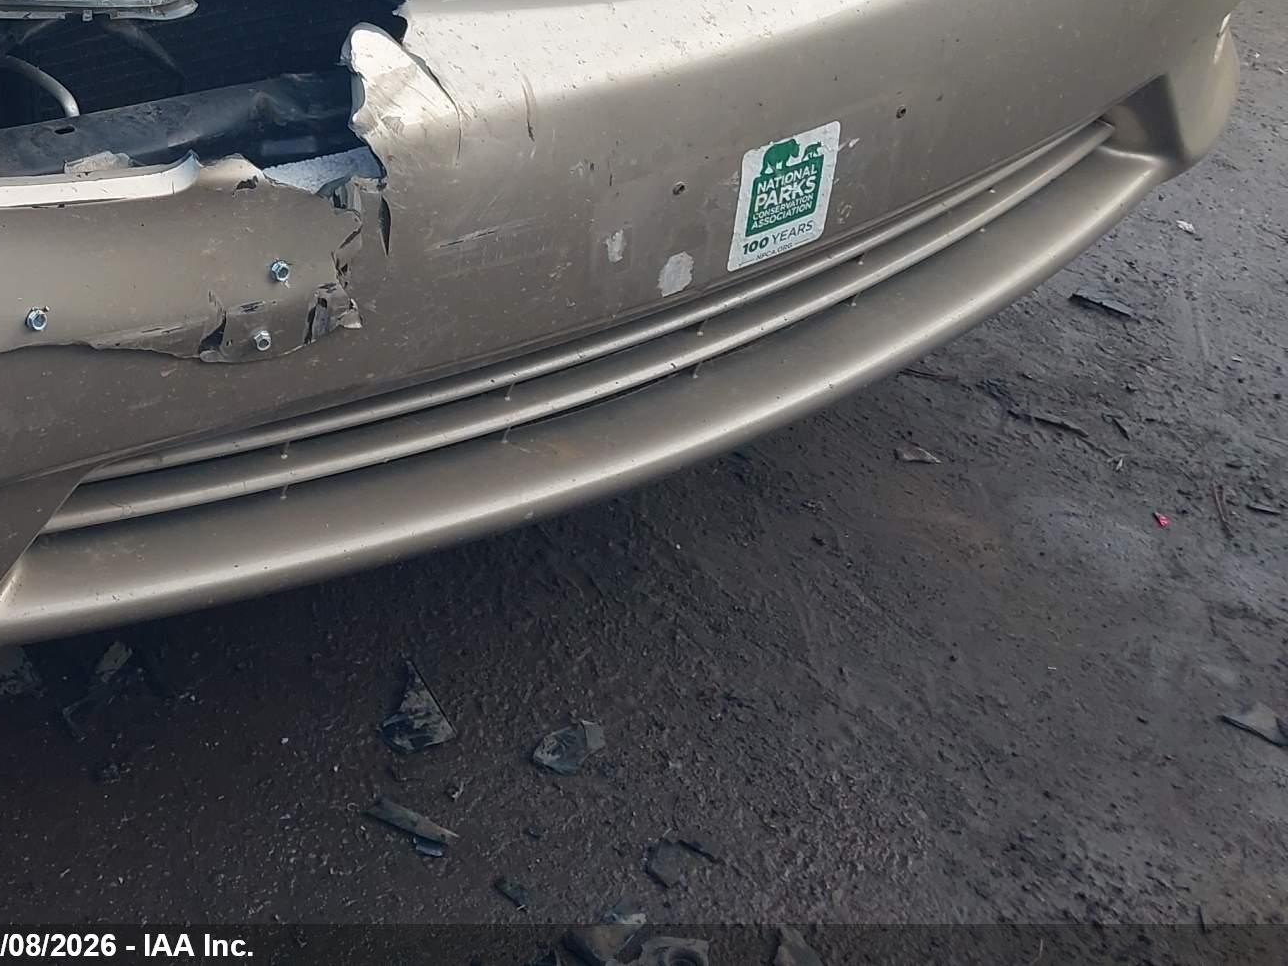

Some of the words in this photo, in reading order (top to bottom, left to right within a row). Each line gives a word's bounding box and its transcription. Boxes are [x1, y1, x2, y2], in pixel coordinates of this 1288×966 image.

[754, 175, 817, 212] PARKS
[757, 163, 817, 194] NATIONAL
[751, 200, 813, 230] ASSOCIATION
[752, 193, 814, 220] CONSERVATION
[742, 237, 769, 254] 100
[772, 220, 814, 245] YEARS
